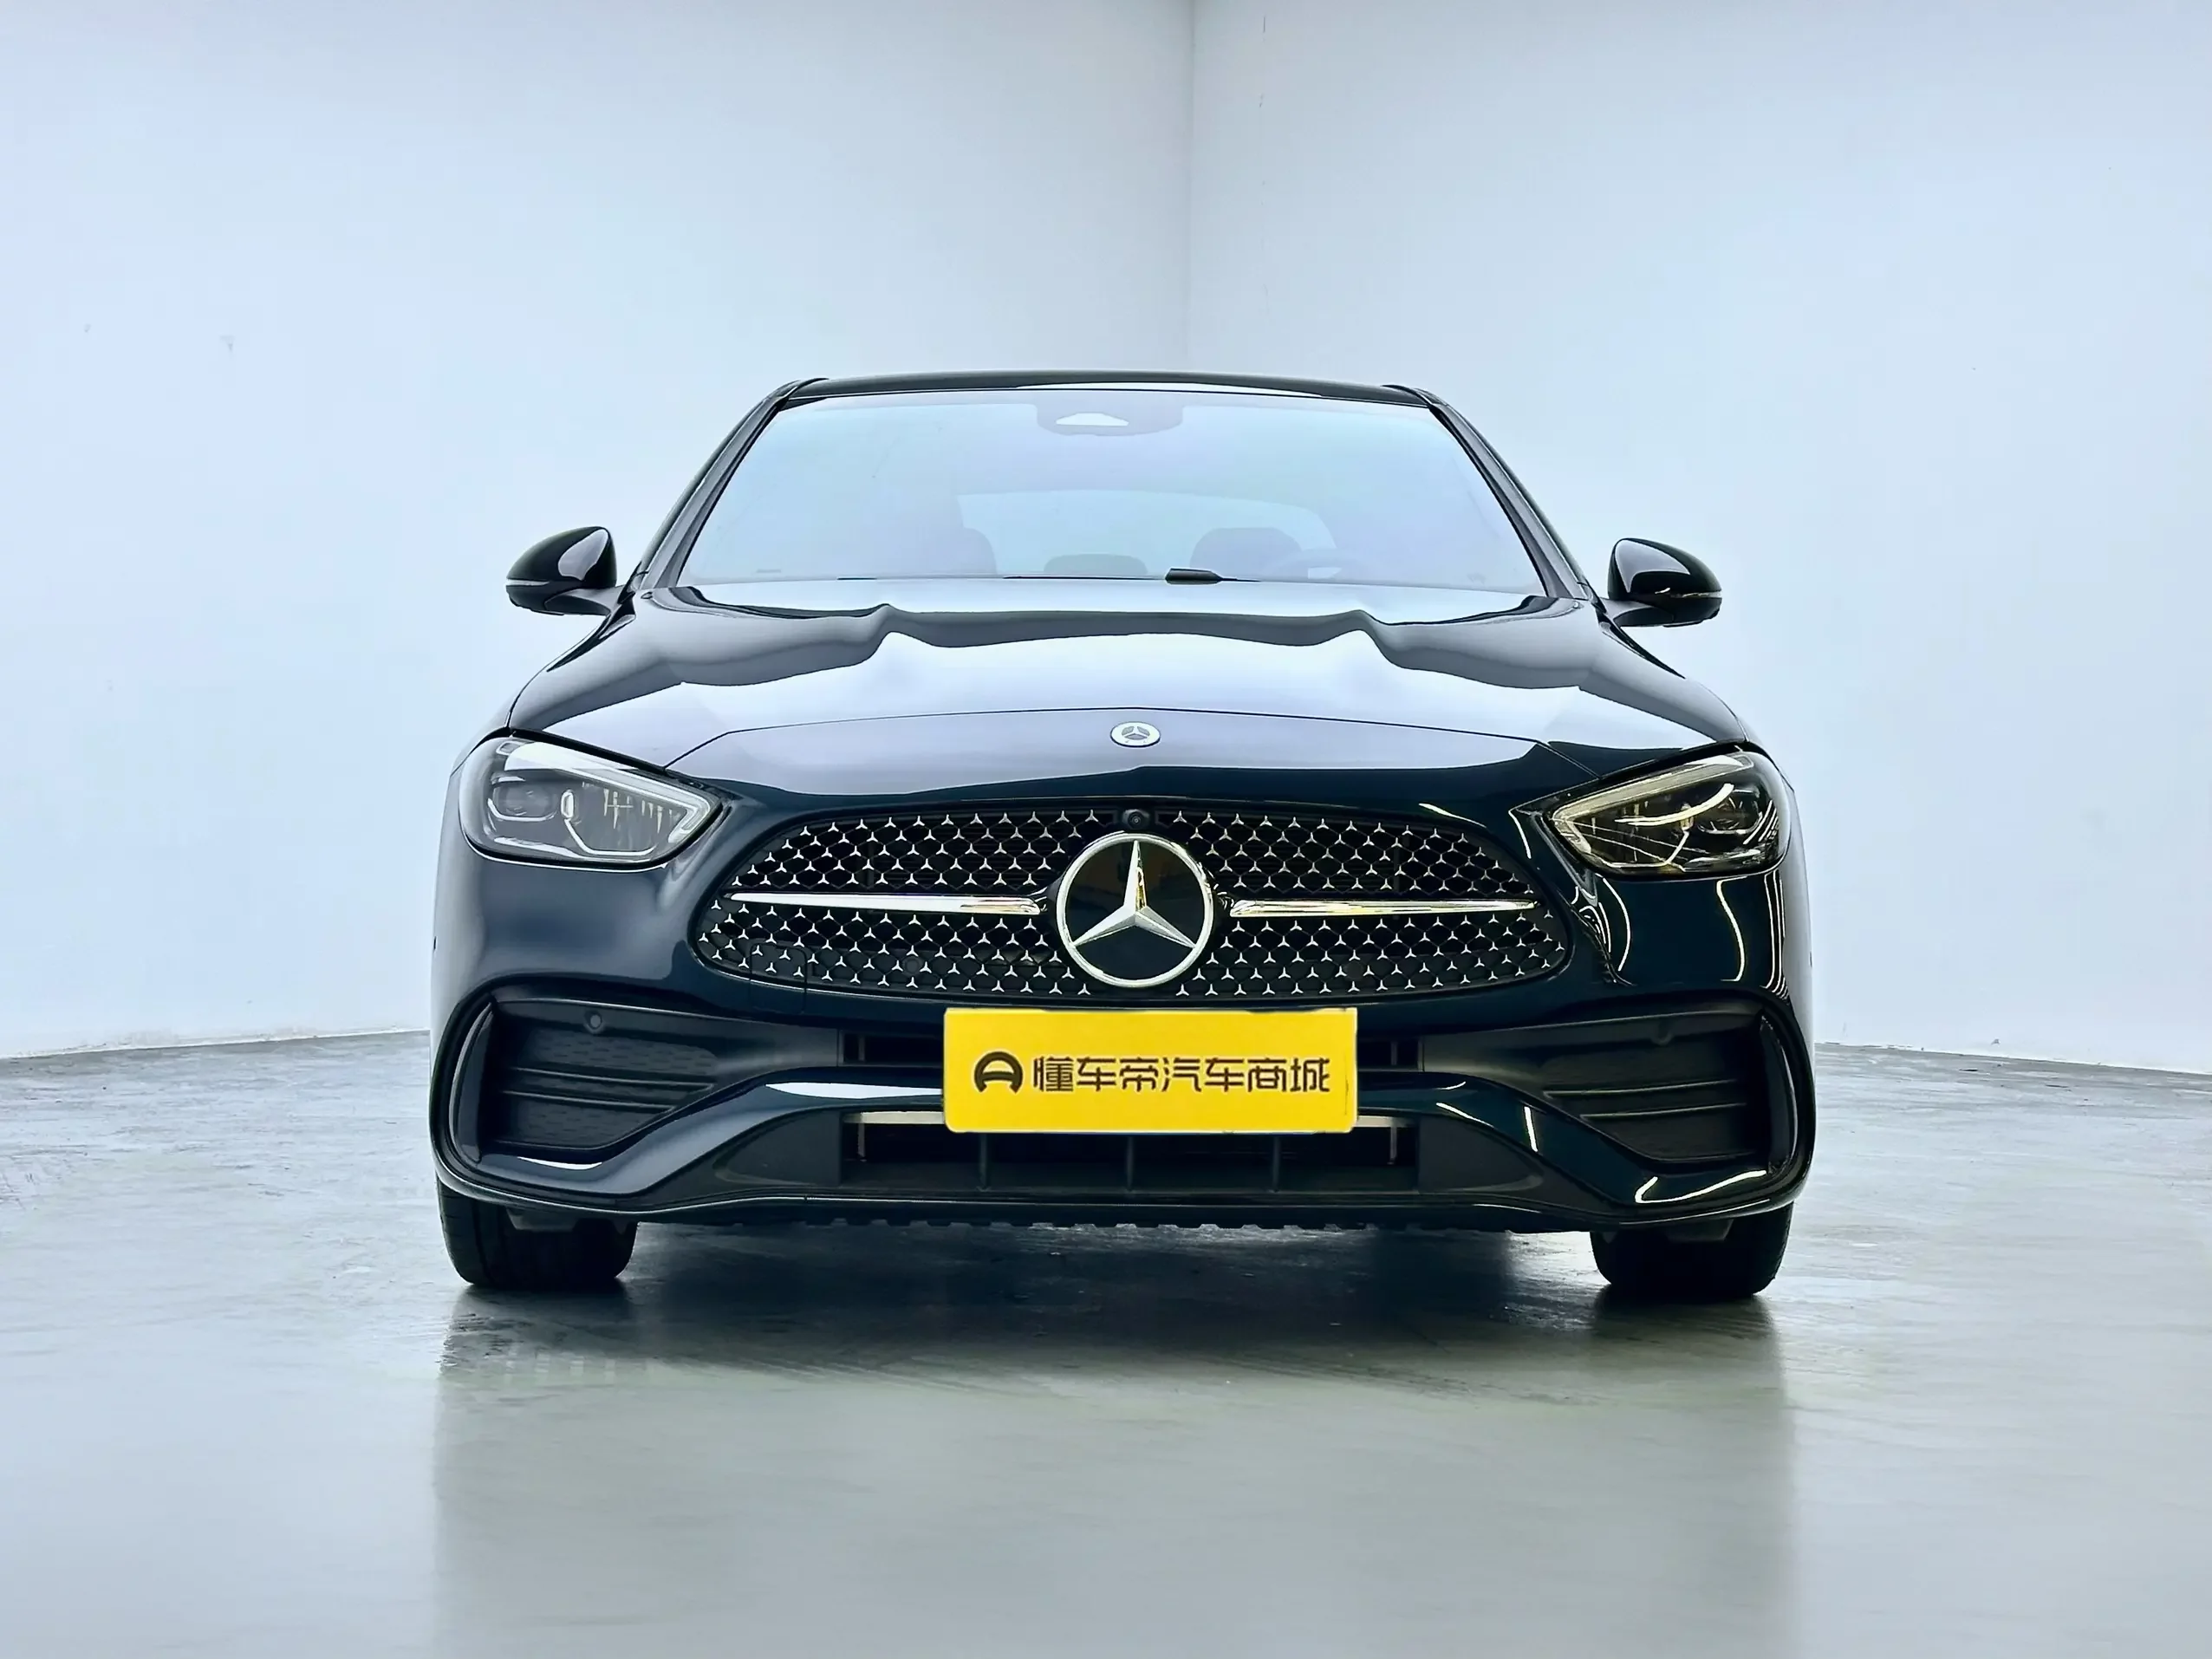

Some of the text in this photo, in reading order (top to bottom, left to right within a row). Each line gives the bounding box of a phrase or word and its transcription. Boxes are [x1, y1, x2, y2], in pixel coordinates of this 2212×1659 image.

[1032, 1056, 1330, 1093] 懂车帝汽车商城
